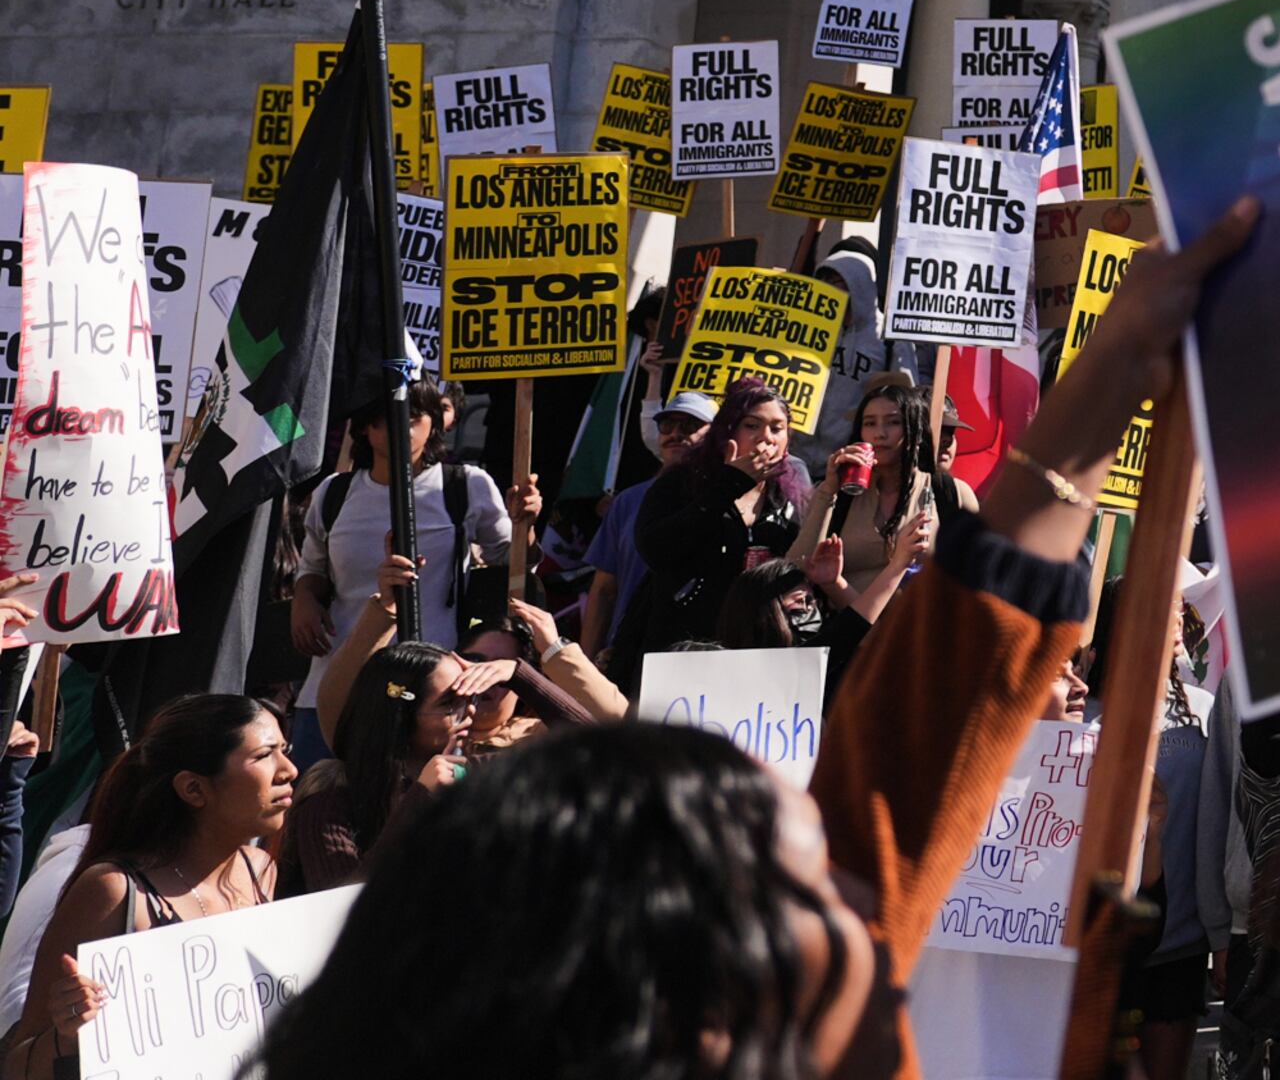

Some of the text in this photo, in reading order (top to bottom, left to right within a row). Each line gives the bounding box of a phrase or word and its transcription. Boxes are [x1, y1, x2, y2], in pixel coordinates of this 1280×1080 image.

[825, 4, 899, 33] FOR ALL
[820, 27, 899, 49] IMMIGRANTS
[973, 26, 1035, 52] FULL
[692, 49, 758, 76] FULL
[961, 52, 1050, 77] RIGHTS
[455, 74, 528, 107] FULL
[680, 74, 772, 102] RIGHTS
[444, 98, 546, 133] RIGHTS
[805, 93, 906, 128] LOS ANGELES
[681, 120, 771, 144] FOR ALL
[795, 123, 896, 156] MINNEAPOLIS
[679, 142, 773, 160] IMMIGRANTS
[786, 153, 886, 180] STOP
[503, 165, 577, 178] FROM
[928, 151, 1008, 197] FULL
[455, 171, 620, 209] LOS ANGELES
[778, 171, 880, 206] ICE TERROR
[521, 214, 557, 226] TO
[909, 188, 1025, 235] RIGHTS
[453, 222, 618, 260] MINNEAPOLIS
[693, 247, 721, 271] NO
[903, 256, 1016, 295] FOR ALL
[452, 272, 619, 305] STOP
[710, 277, 840, 321] LOS ANGELES
[896, 291, 1016, 319] IMMIGRANTS
[30, 280, 115, 359] the
[452, 303, 616, 349] ICE TERROR
[755, 306, 785, 319] TO
[698, 309, 829, 352] MINNEAPOLIS
[453, 349, 614, 369] PARTY FOR SOCIALISM & LIBERATION
[689, 341, 822, 376] STOP
[679, 362, 722, 390] ICE
[24, 370, 124, 437] dream
[25, 449, 150, 499] have to be
[26, 513, 142, 569] believe
[91, 945, 164, 1064] Mi
